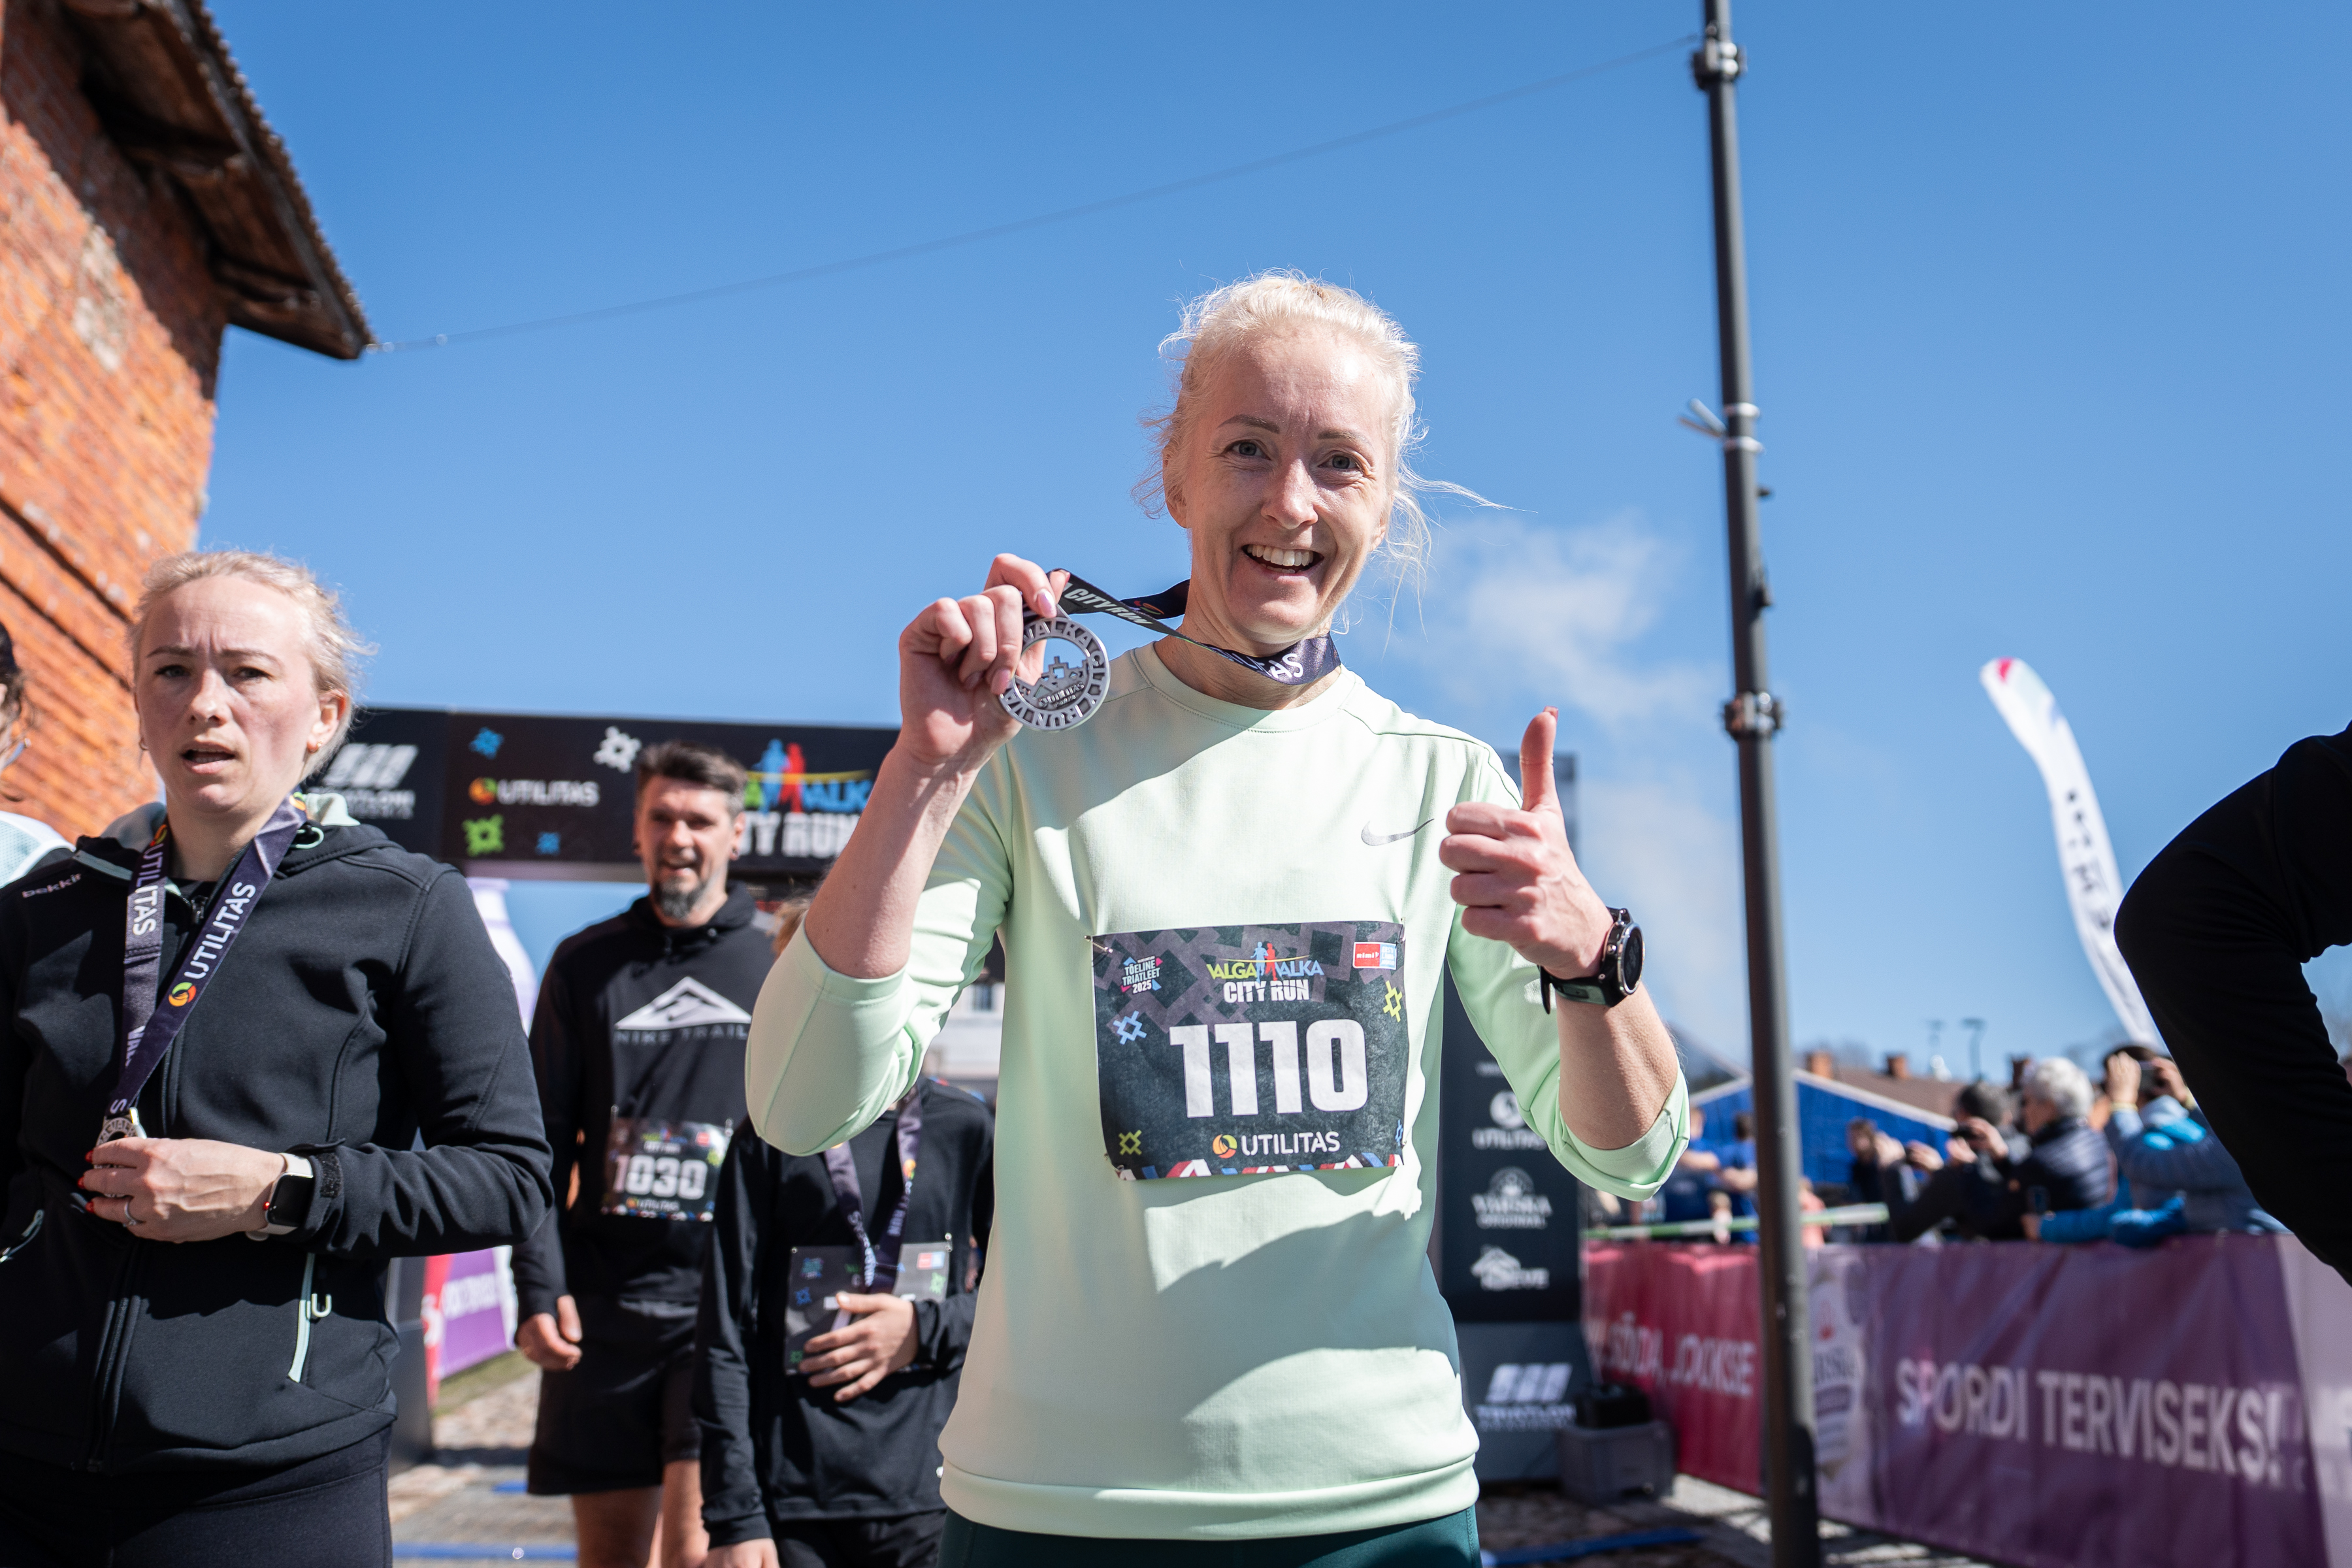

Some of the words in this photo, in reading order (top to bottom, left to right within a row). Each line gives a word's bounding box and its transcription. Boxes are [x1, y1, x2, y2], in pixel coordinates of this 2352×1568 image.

[1064, 588, 1117, 608] CITY
[1105, 606, 1154, 625] RUN
[1083, 650, 1105, 707] CITY
[1032, 704, 1083, 727] RUN
[497, 779, 601, 807] UTILITAS
[133, 843, 165, 936] UTILITAS
[184, 881, 257, 980] UTILITAS
[1122, 967, 1160, 987] TRIATLEET
[1124, 959, 1156, 976] TÕELINE
[1132, 979, 1152, 994] 2025
[1223, 980, 1267, 1004] CITY
[1269, 979, 1310, 1002] RUN
[613, 1029, 672, 1045] NIKE
[681, 1022, 749, 1041] TRAIL
[1169, 1019, 1369, 1118] 1110
[1241, 1130, 1341, 1157] UTILITAS
[612, 1153, 709, 1201] 1030
[1895, 1357, 2030, 1441] SPORDI
[2034, 1369, 2285, 1489] TERVISEKS!
